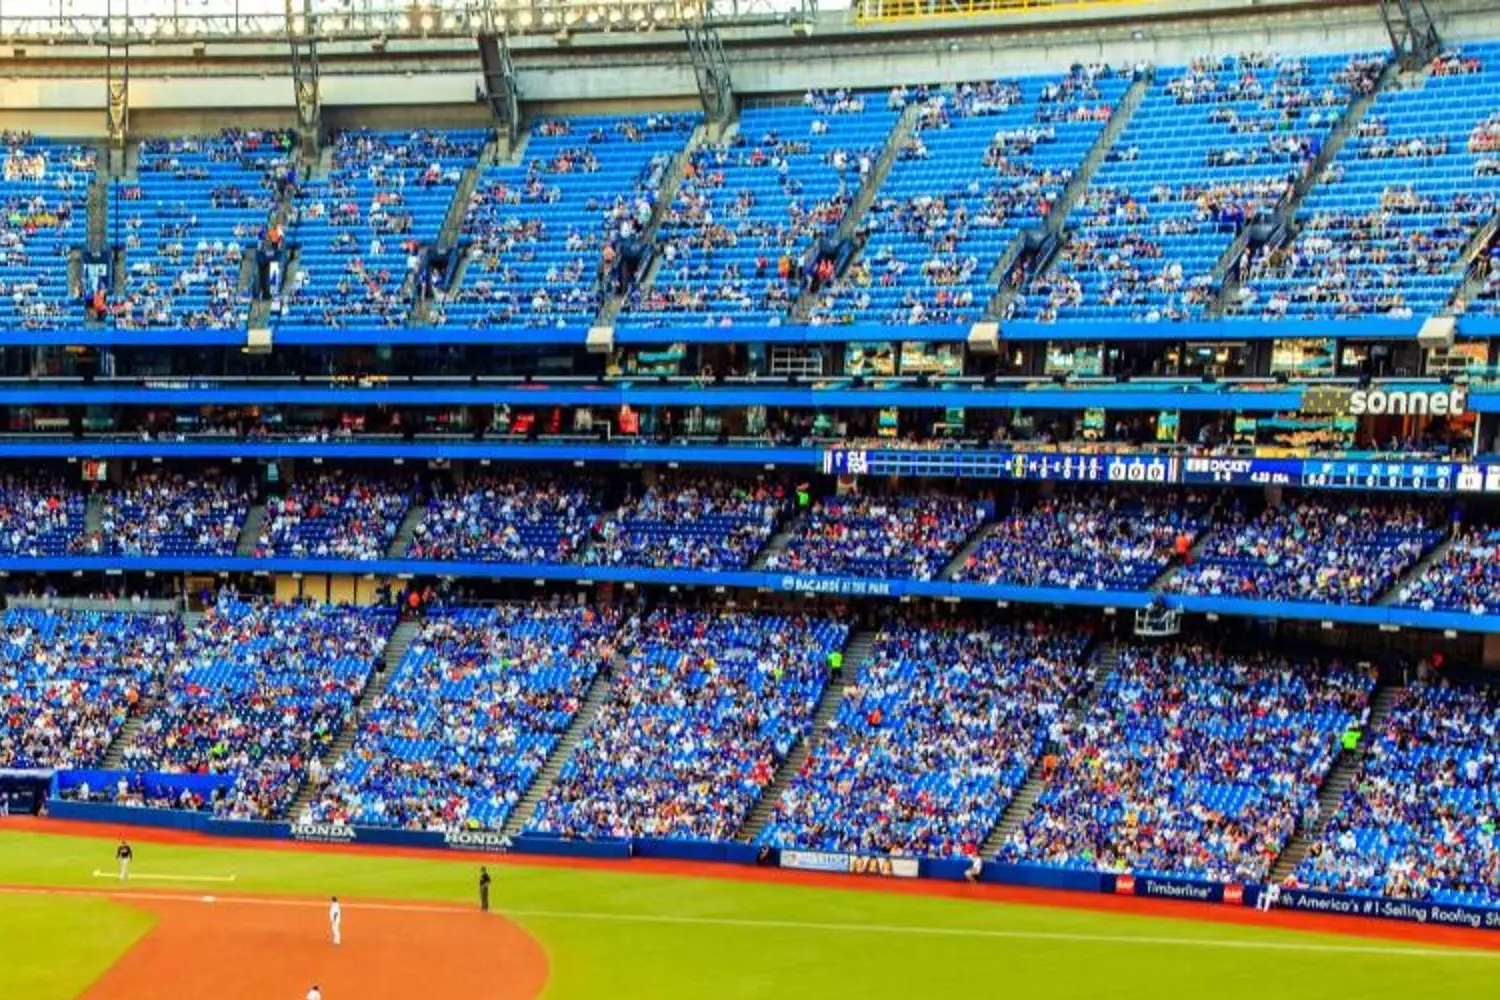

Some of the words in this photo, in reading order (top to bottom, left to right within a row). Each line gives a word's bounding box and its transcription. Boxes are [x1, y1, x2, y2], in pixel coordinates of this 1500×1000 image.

[1350, 386, 1465, 415] sonnet
[1210, 460, 1252, 472] DICKEY
[291, 823, 356, 838] HONDA
[444, 832, 513, 847] HONDA
[1297, 894, 1359, 912] America's
[1431, 907, 1481, 928] Roofing
